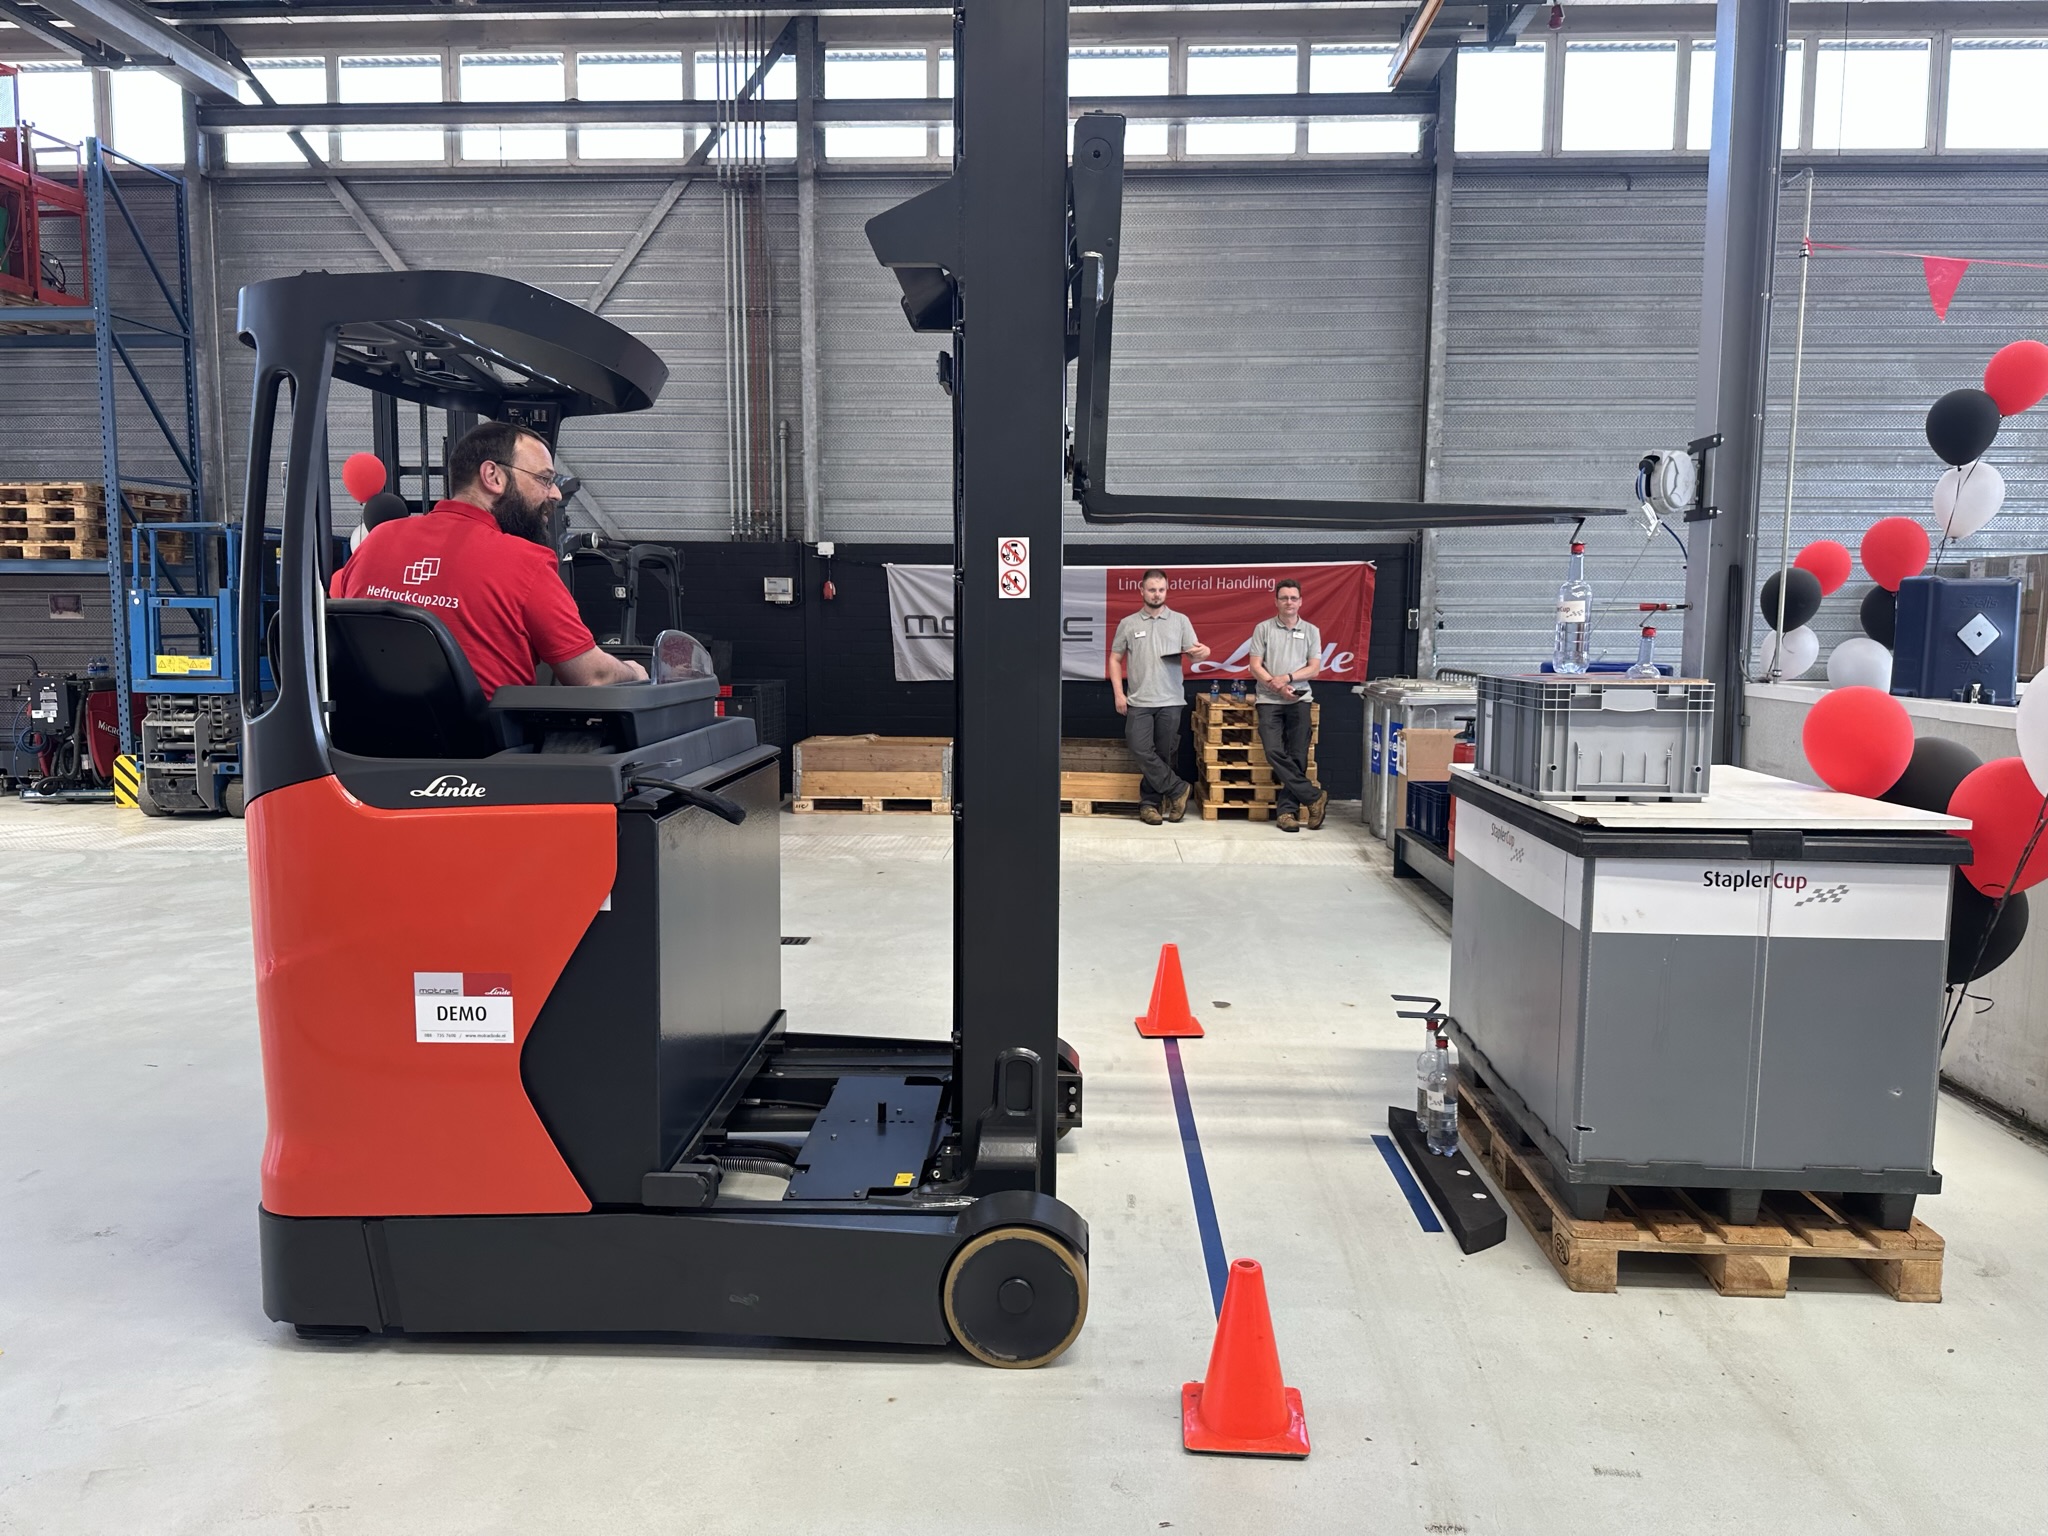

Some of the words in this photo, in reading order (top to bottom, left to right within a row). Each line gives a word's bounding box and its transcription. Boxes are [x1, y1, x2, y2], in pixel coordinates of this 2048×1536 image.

[1118, 577, 1143, 591] Lin
[1216, 575, 1276, 592] Handling
[366, 585, 459, 609] HeftruckCup2023
[410, 774, 486, 798] Linde
[1703, 869, 1807, 893] StaplerCup
[419, 987, 459, 995] motrac
[484, 987, 511, 995] Linde
[437, 1005, 487, 1021] DEMO
